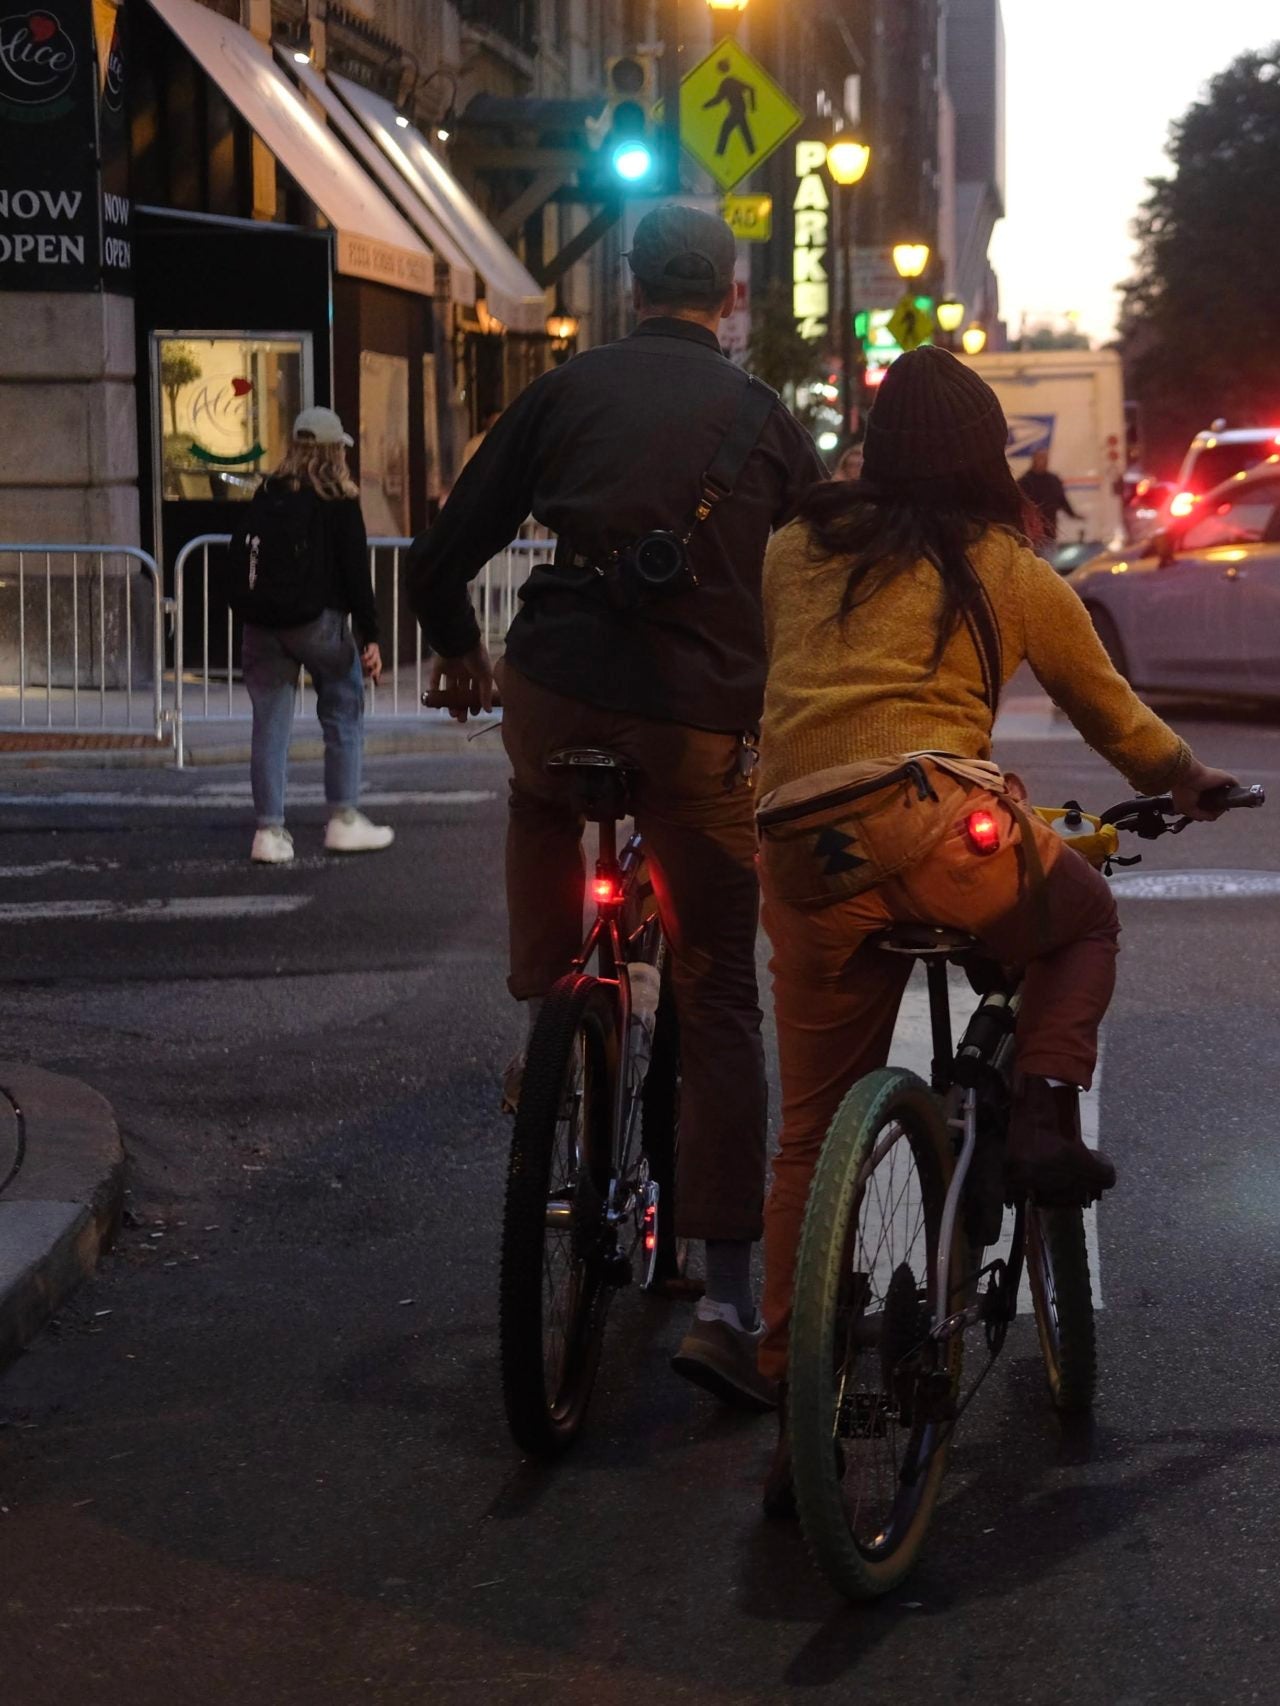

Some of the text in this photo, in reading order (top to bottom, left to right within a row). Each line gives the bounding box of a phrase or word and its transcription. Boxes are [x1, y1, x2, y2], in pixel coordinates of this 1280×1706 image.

[104, 191, 130, 226] NOW
[793, 140, 829, 283] PARK
[105, 236, 131, 269] OPEN
